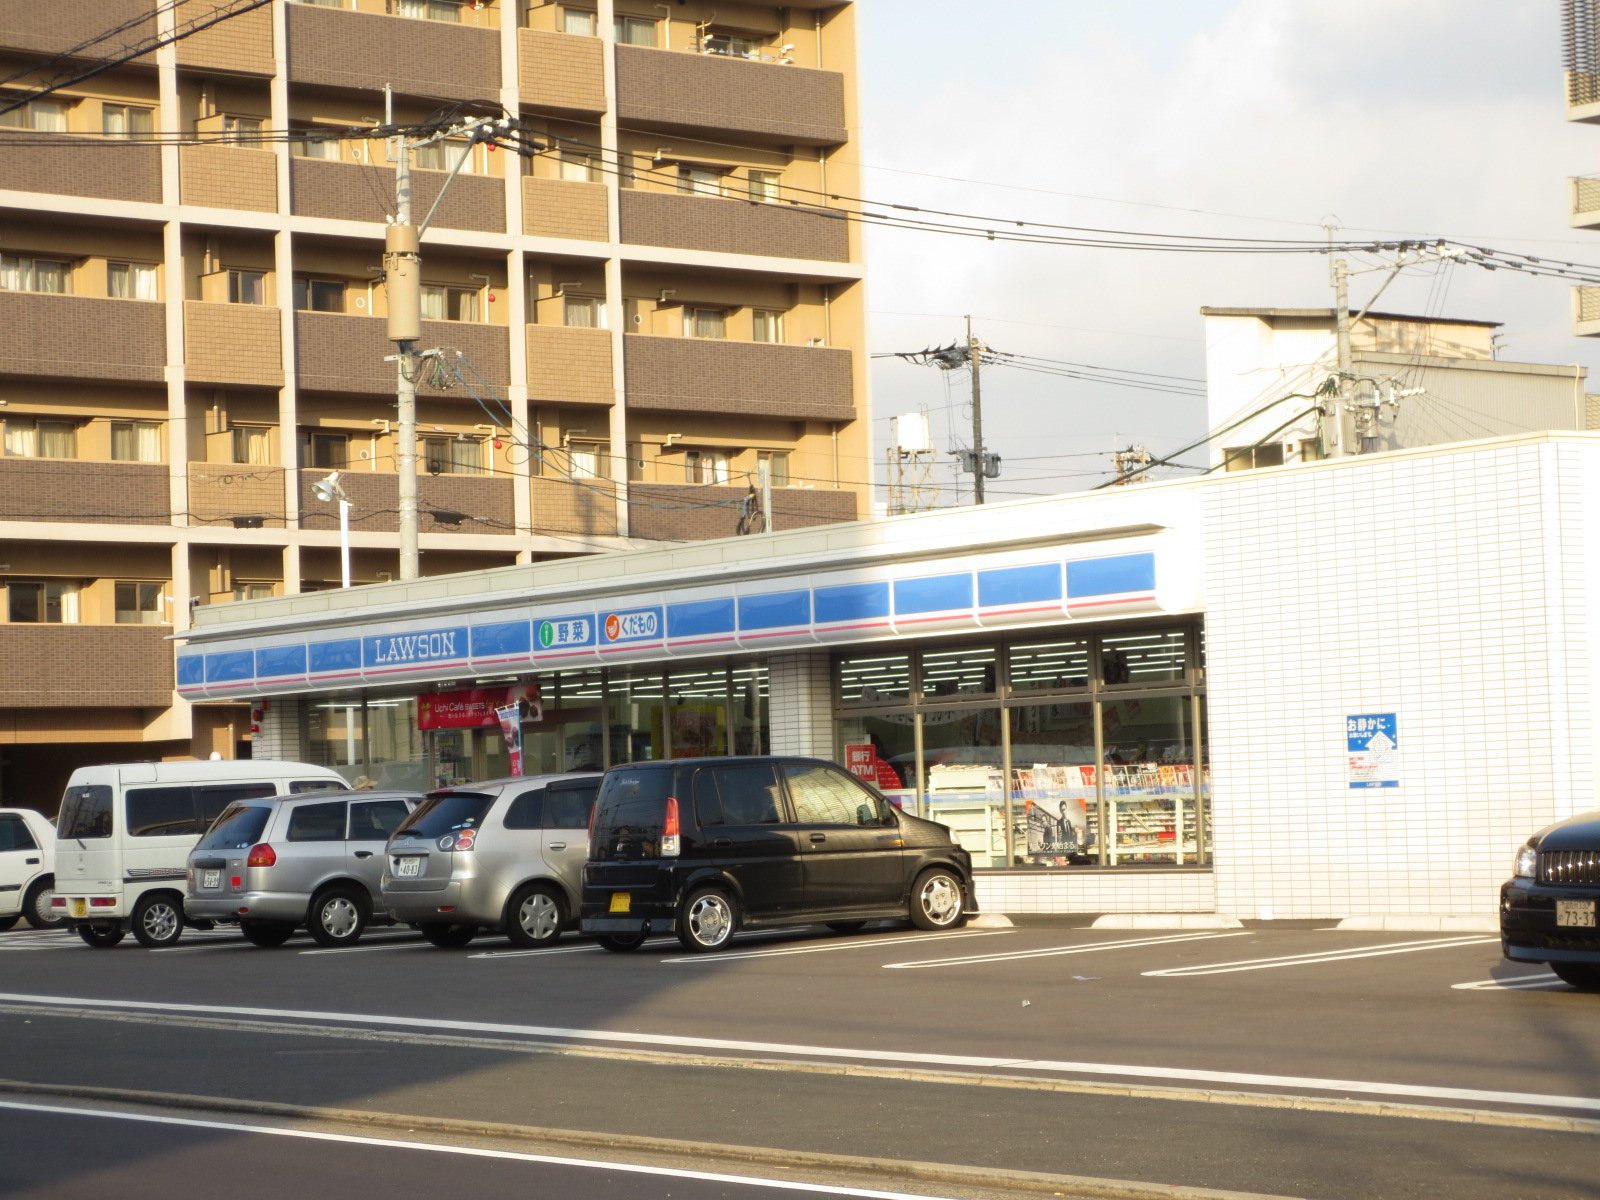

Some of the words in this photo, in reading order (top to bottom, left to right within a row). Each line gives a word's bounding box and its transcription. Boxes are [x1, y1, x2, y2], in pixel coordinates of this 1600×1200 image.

[558, 620, 585, 642] 野菜
[622, 614, 655, 635] くだもの
[375, 631, 456, 663] LAWSON
[850, 764, 873, 776] ATM
